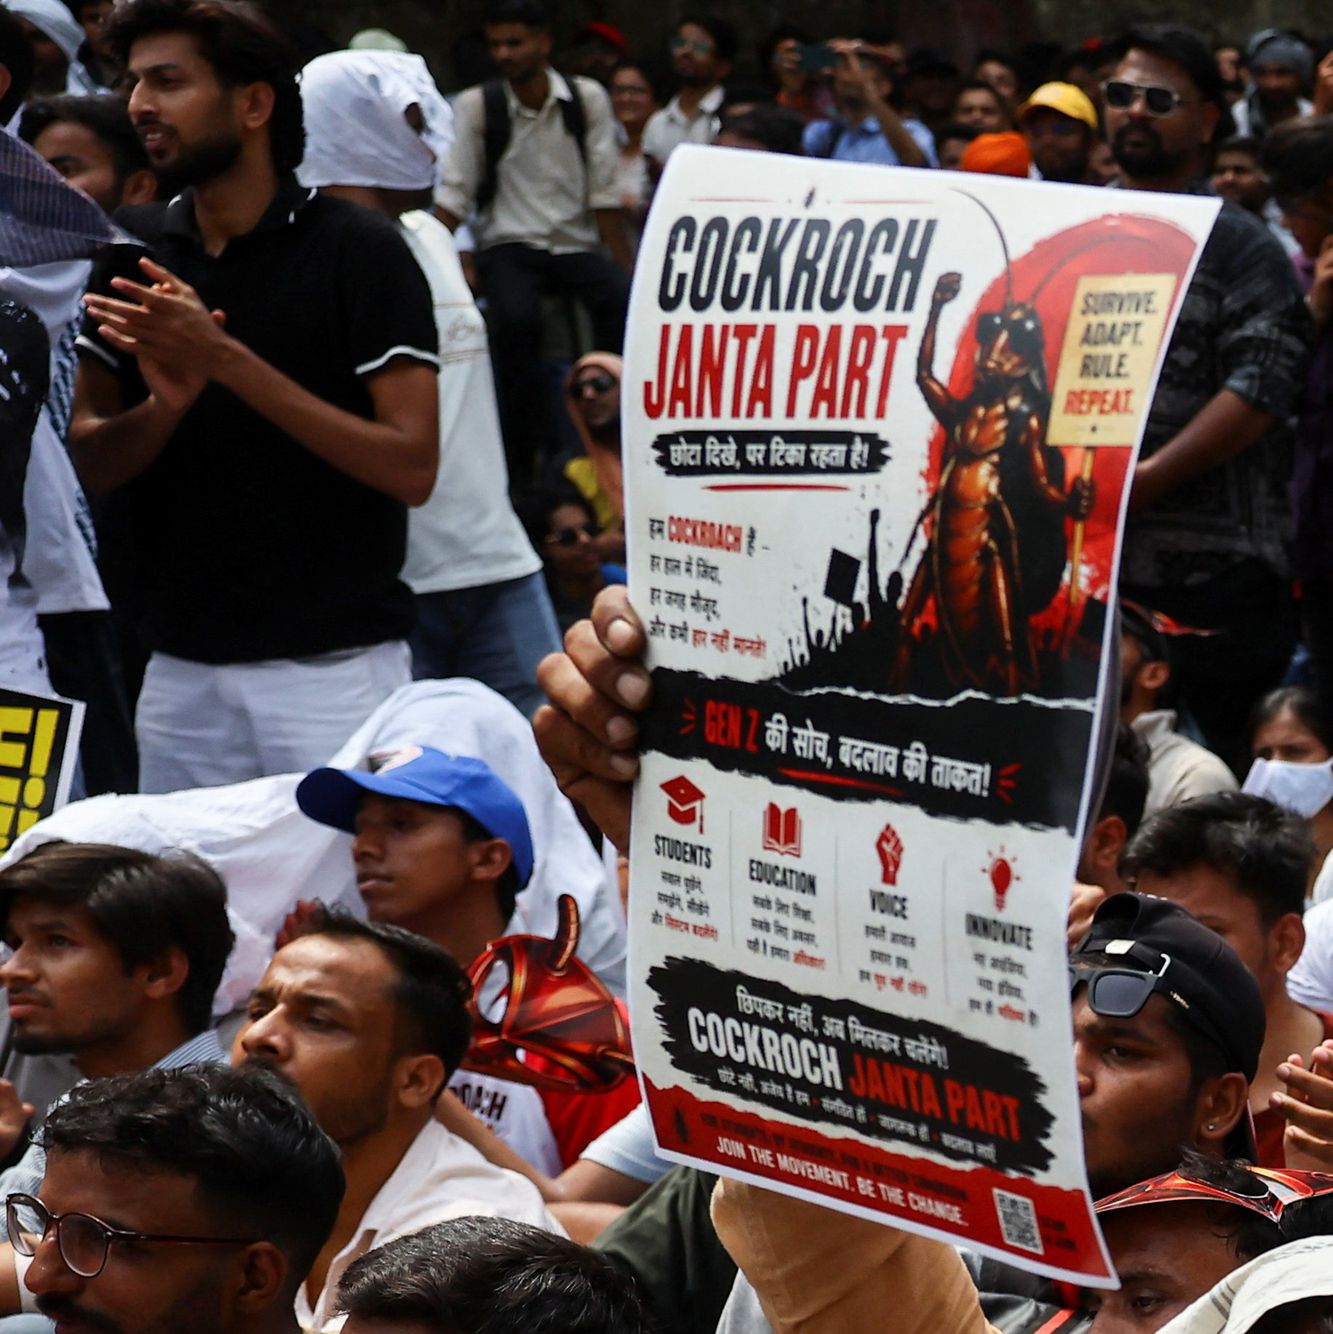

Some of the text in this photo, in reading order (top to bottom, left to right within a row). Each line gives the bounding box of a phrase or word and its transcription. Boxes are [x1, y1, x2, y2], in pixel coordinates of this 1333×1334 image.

[659, 215, 938, 313] COCKROCH
[1081, 291, 1158, 316] SURVIVE.
[1080, 322, 1143, 347] ADAPT.
[643, 324, 909, 420] JANTA PART
[1080, 353, 1131, 379] RULE.
[1063, 388, 1134, 415] REPEAT.
[670, 437, 702, 467] छोटा
[705, 436, 741, 469] दिखे,
[746, 443, 766, 467] पर
[770, 436, 806, 467] टिका
[809, 443, 847, 468] रहता
[668, 516, 742, 553] COCKROACH
[704, 699, 991, 798] GEN Z की सोच, बदलाव की ताकत!
[654, 834, 712, 869] STUDENTS
[749, 859, 817, 897] EDUCATION
[869, 889, 908, 920] VOICE
[965, 912, 1032, 951] INNOVATE
[822, 1015, 847, 1041] अब
[847, 1015, 902, 1057] मिलकर
[687, 1006, 1022, 1143] COCKROCH JANTA PART
[716, 1136, 969, 1227] JOIN THE MOVEMENT. BE THE CHANGE.
